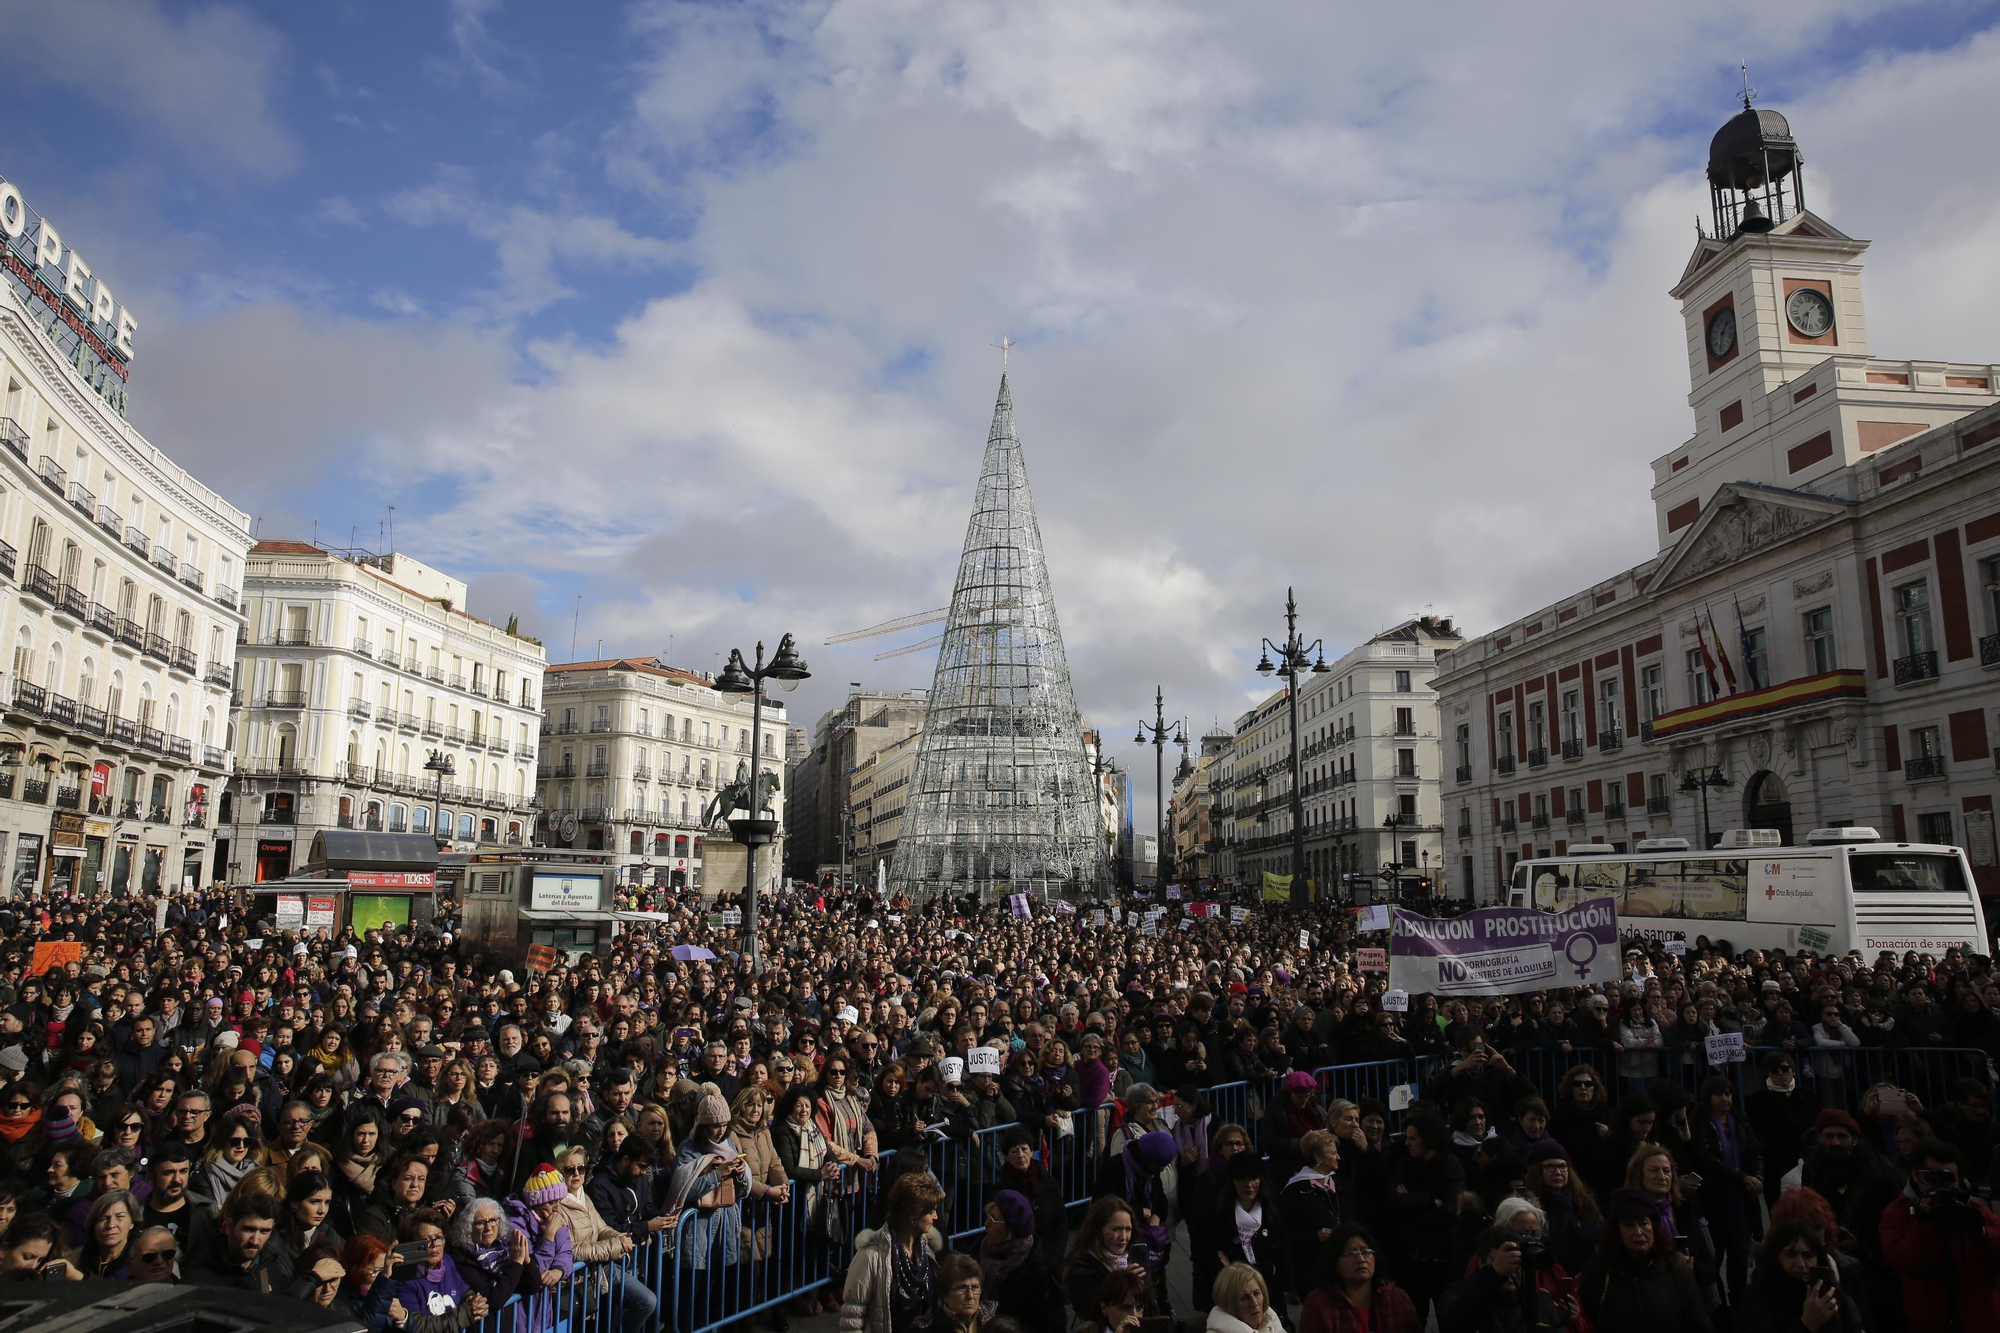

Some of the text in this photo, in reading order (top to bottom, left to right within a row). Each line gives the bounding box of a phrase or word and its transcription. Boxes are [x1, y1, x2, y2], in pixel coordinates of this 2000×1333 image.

[35, 217, 138, 361] PEPE
[120, 832, 139, 841] SEPHORA
[18, 838, 38, 849] PRIMOR
[186, 840, 206, 848] SEPHORA
[261, 844, 288, 853] Orange
[403, 873, 431, 885] TICKETS
[1775, 889, 1785, 897] Cruz
[1795, 889, 1814, 898] Española
[1392, 905, 1612, 940] ABOLICION PROSTITUCIÓN
[1626, 923, 1641, 940] de
[1866, 938, 1918, 949] Donación
[1919, 938, 1934, 949] de
[1358, 951, 1383, 959] Pegar,
[1464, 953, 1520, 969] PORNOGRAFÍA
[1438, 960, 1467, 983] NO
[1469, 960, 1553, 980] VIENTRES DE ALQUILER
[1710, 1037, 1740, 1049] SI DUELE,
[969, 1052, 999, 1066] JUSTICIA
[1709, 1051, 1718, 1061] NO
[1719, 1050, 1726, 1060] ES
